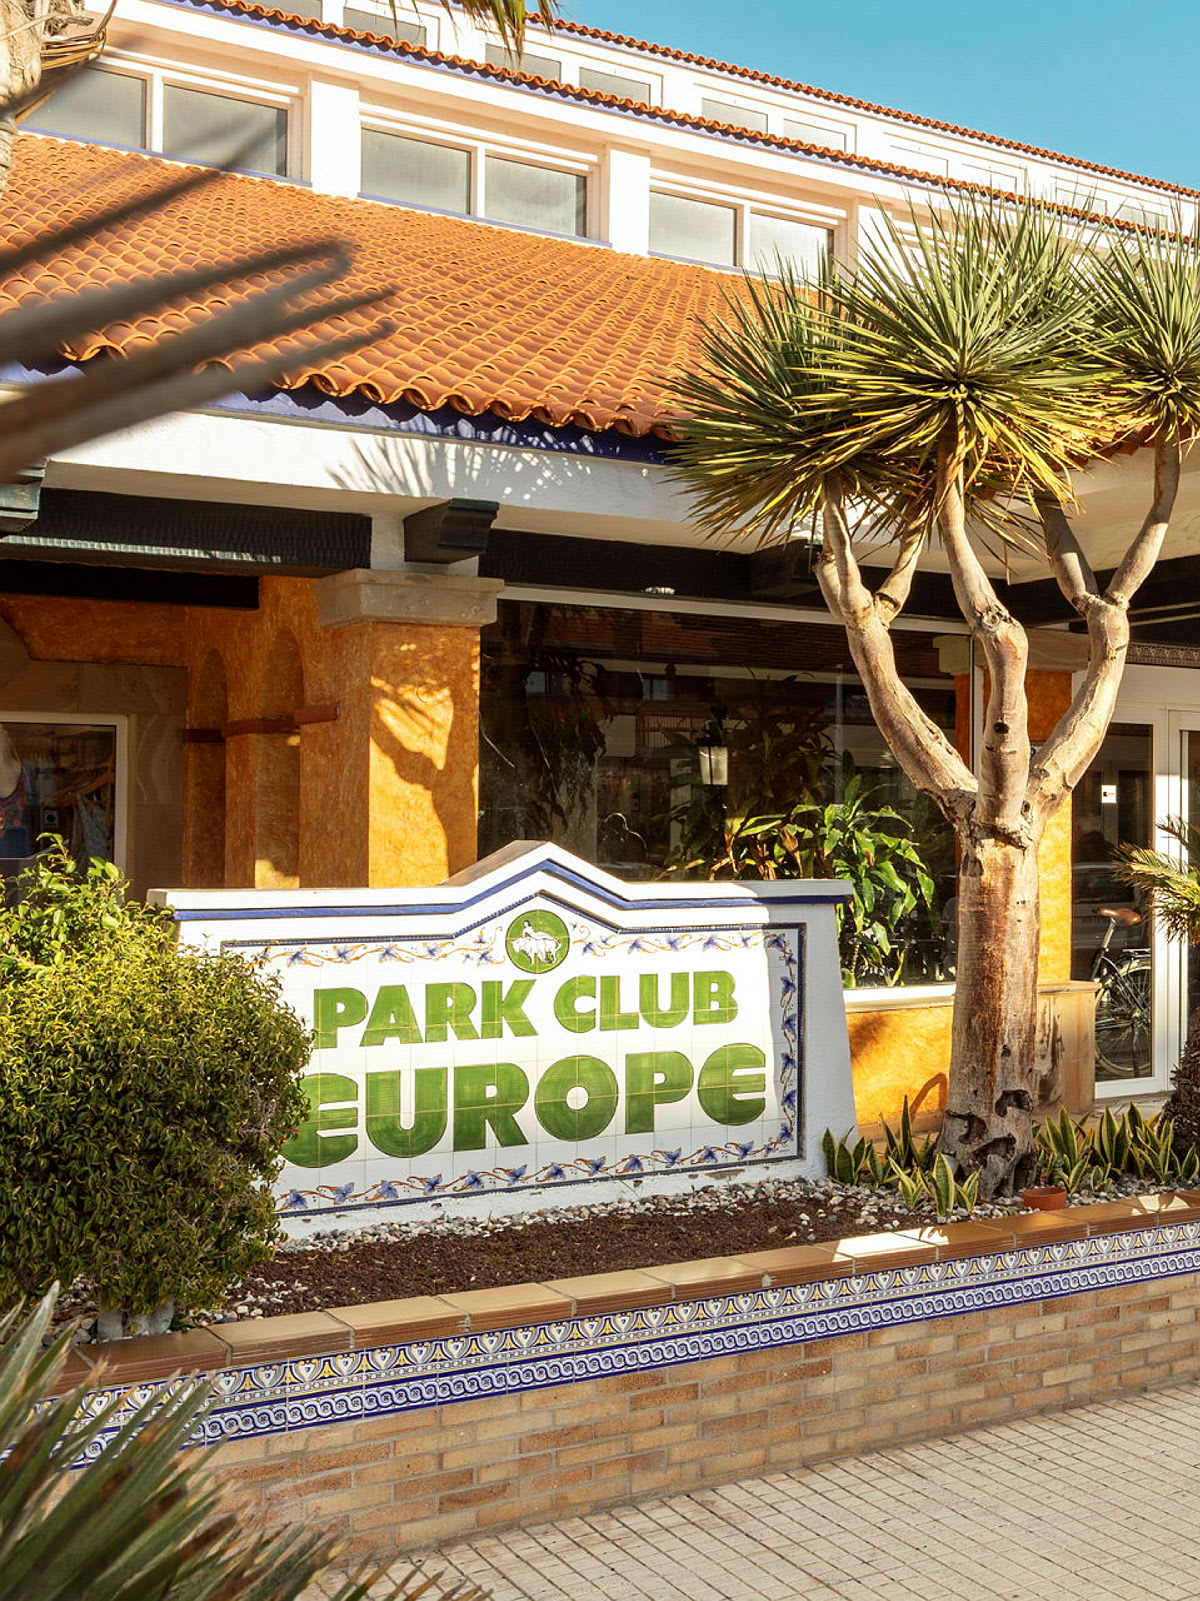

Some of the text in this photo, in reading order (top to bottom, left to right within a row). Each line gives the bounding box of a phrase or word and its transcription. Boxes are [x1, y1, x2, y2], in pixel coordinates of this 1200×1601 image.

[313, 970, 738, 1049] PARK CLUB
[279, 1043, 766, 1168] EUROPE
